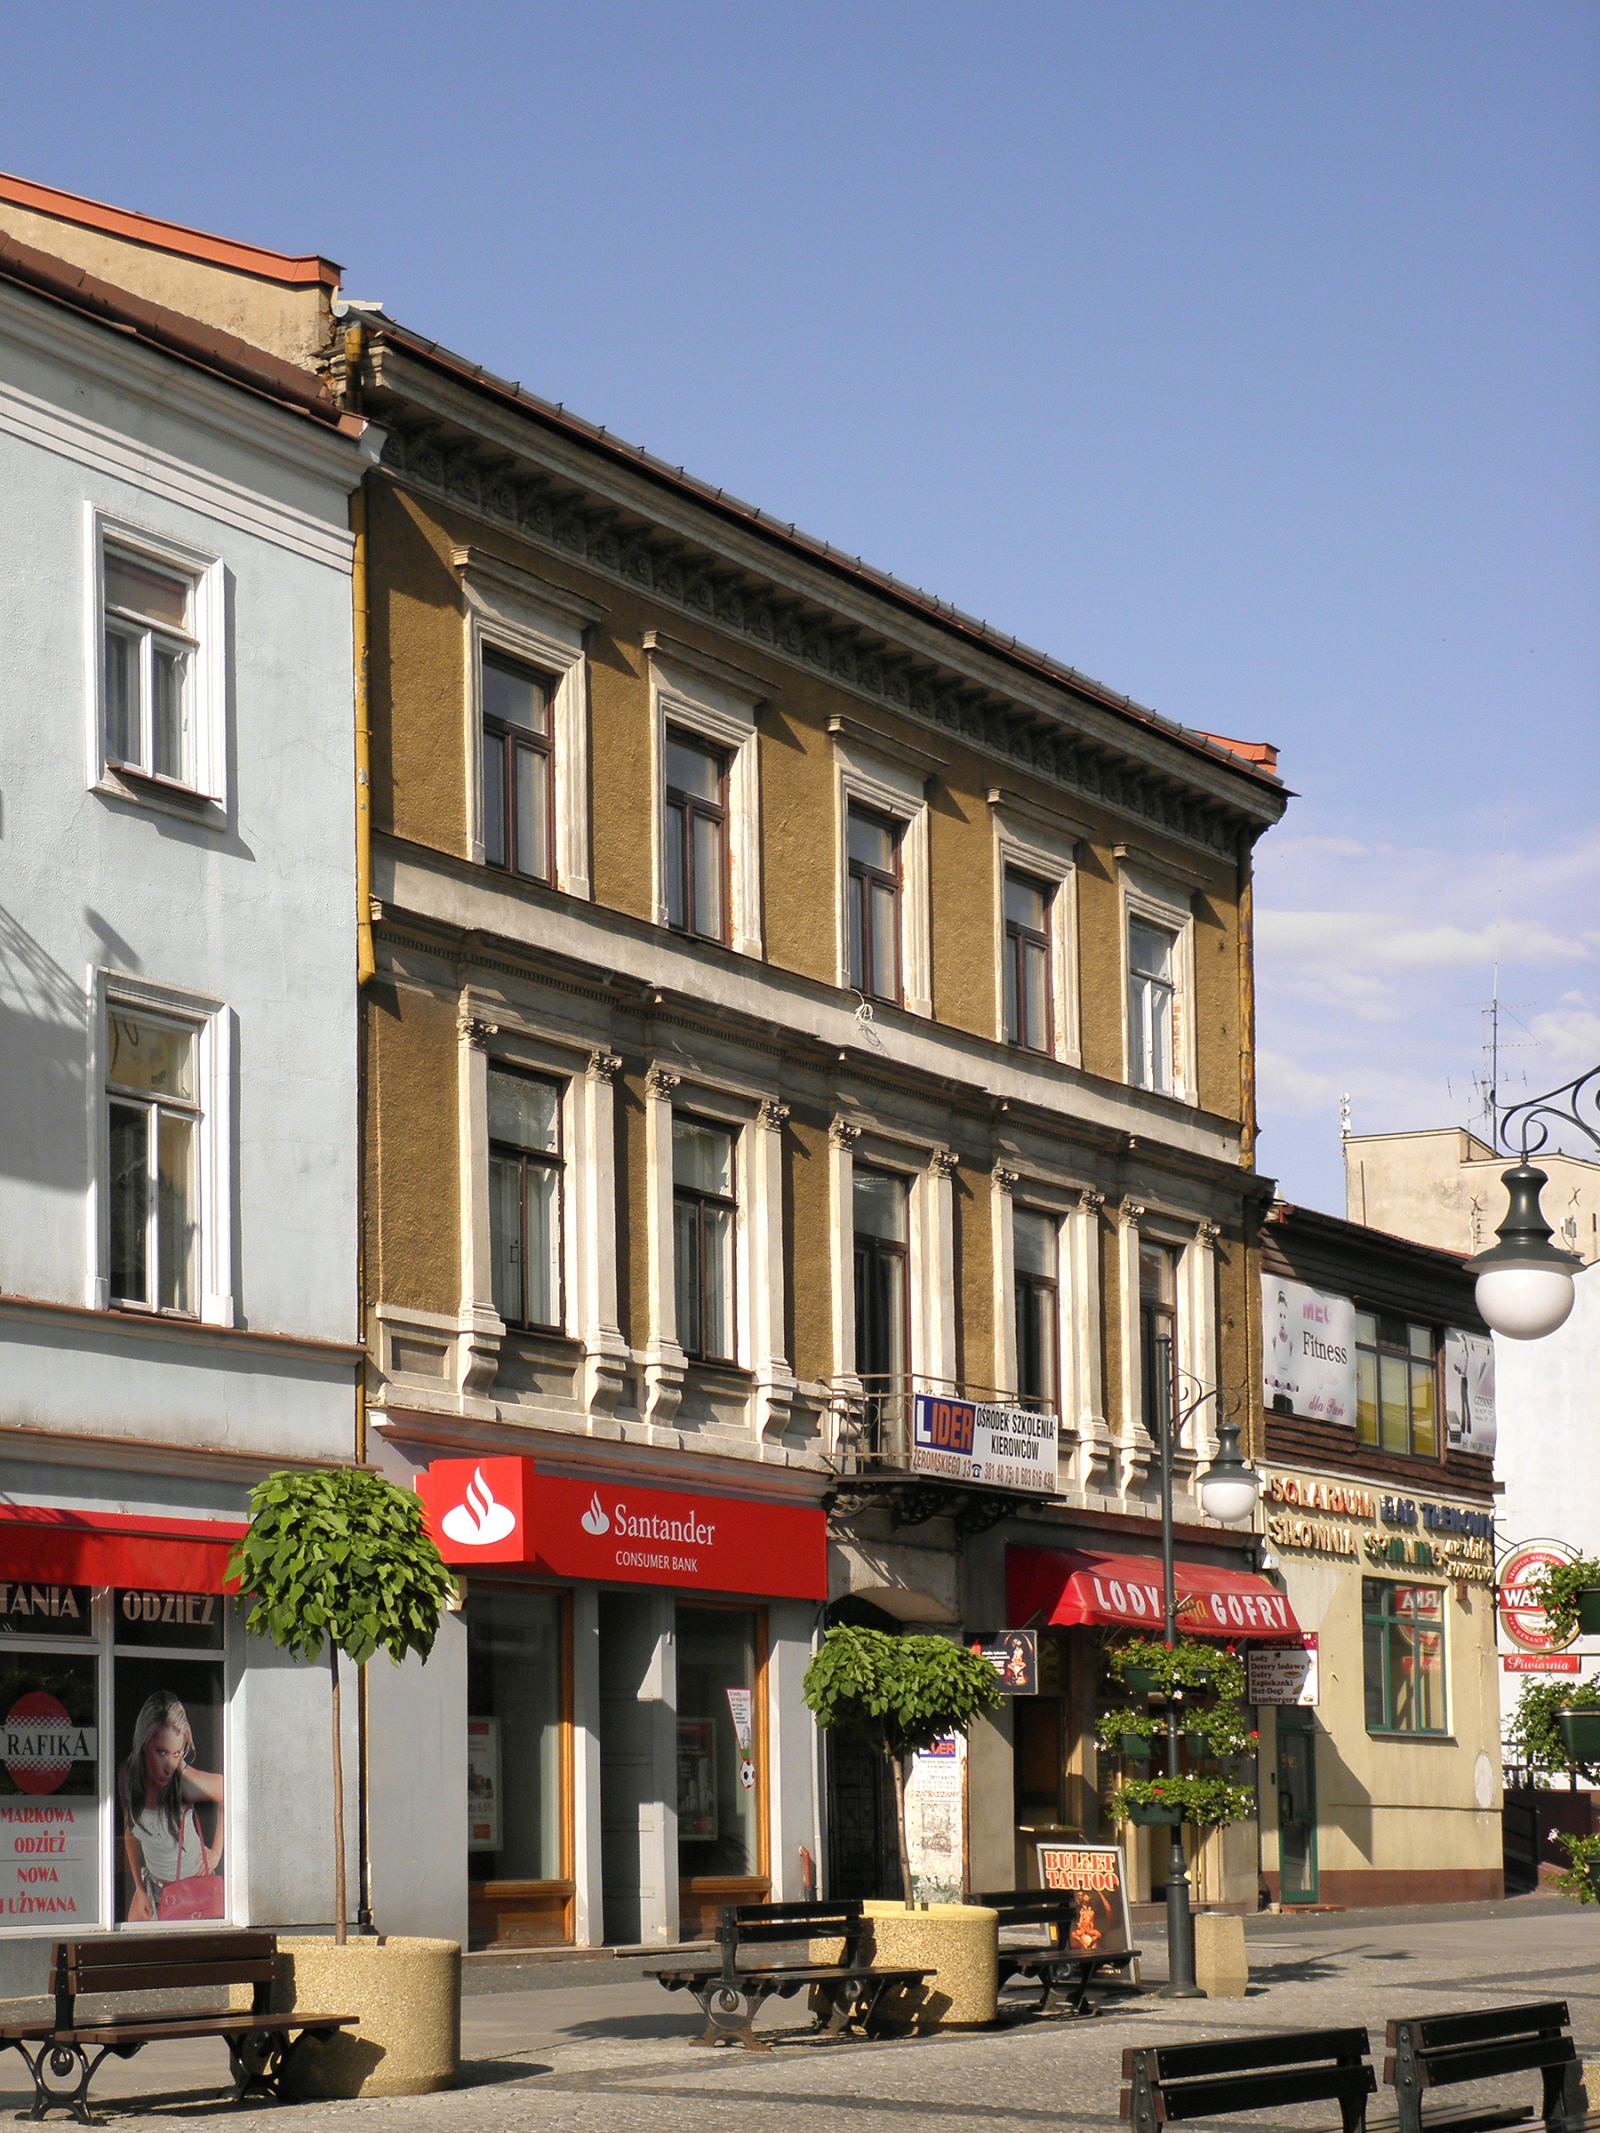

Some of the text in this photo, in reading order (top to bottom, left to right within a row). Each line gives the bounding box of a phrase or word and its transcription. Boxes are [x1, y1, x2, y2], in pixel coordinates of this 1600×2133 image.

[1303, 1331, 1348, 1365] Fitness
[1308, 1395, 1324, 1413] dla
[916, 1400, 973, 1450] LIDER
[976, 1405, 1055, 1440] OŚRODEK SZKOLENIA
[991, 1434, 1040, 1461] KIEROWCÓW
[1271, 1475, 1376, 1518] SOLARIUM
[1379, 1494, 1418, 1525] BAR
[614, 1503, 716, 1546] Santander
[1268, 1516, 1444, 1567] SIŁOWNIA SPINNING
[615, 1550, 698, 1573] CONSUMER BANK
[0, 1583, 80, 1618] TANIA
[1093, 1577, 1161, 1619] LODY
[1210, 1593, 1289, 1629] GOFRY
[1250, 1654, 1268, 1663] Lody
[1250, 1663, 1275, 1671] Desery
[1507, 1655, 1569, 1671] Piwiarnia
[1250, 1671, 1272, 1680] Gofry
[1251, 1680, 1294, 1688] Zapiekanki
[1251, 1696, 1297, 1705] Hamburgery
[0, 1729, 90, 1757] RAFIKA
[0, 1807, 75, 1823] MARKOWA
[14, 1829, 66, 1853] ODZIEŻ
[1044, 1851, 1116, 1872] BULLET
[17, 1867, 59, 1883] NOWA
[1046, 1870, 1120, 1892] TATTOO
[9, 1890, 77, 1914] UŻYWANA
